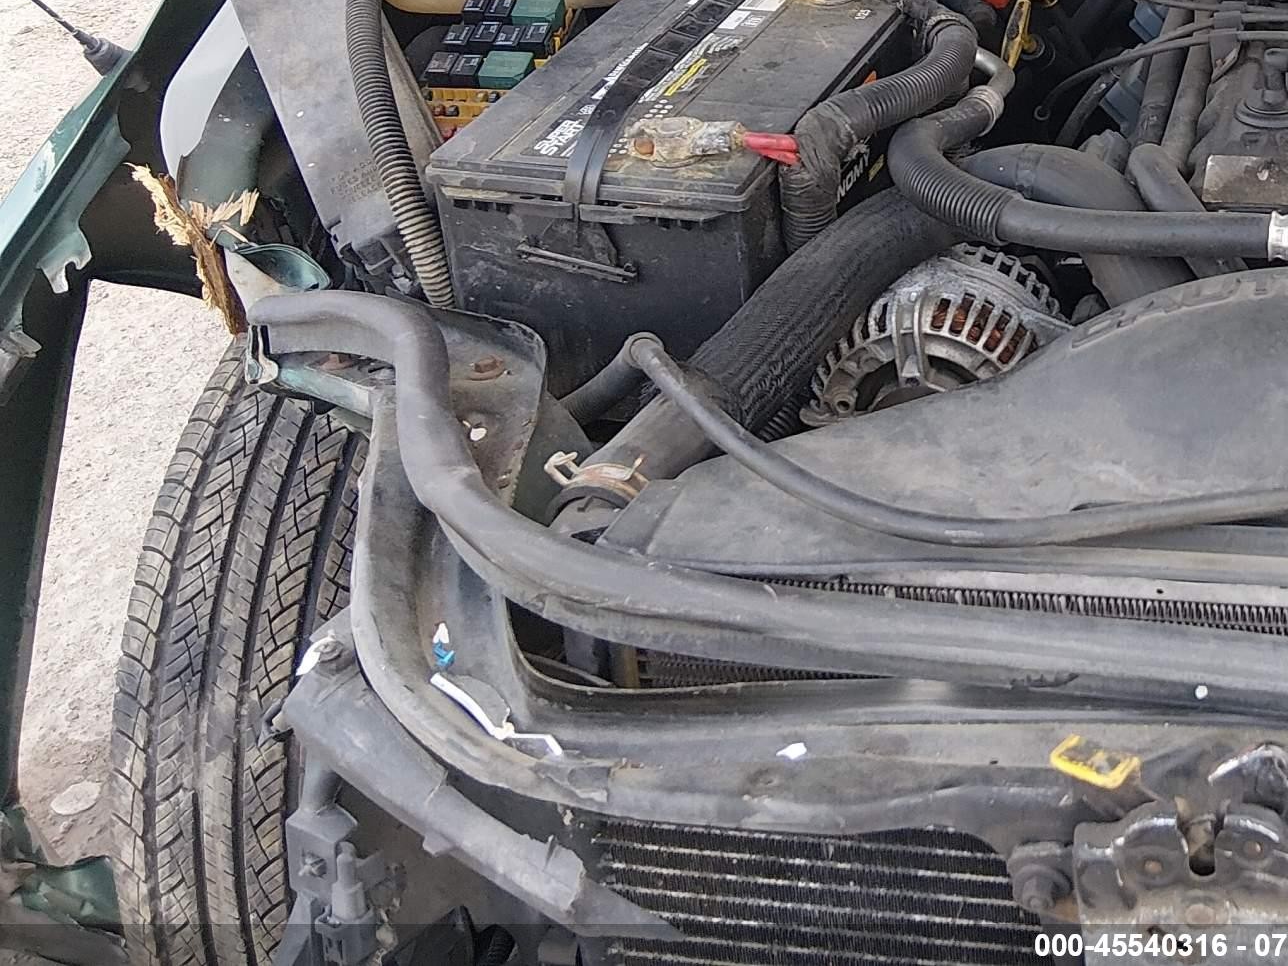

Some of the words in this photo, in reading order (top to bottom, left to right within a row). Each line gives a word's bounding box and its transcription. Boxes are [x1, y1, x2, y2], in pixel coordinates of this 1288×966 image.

[534, 119, 575, 151] SUPER
[540, 120, 585, 155] START
[836, 147, 870, 202] NOMY
